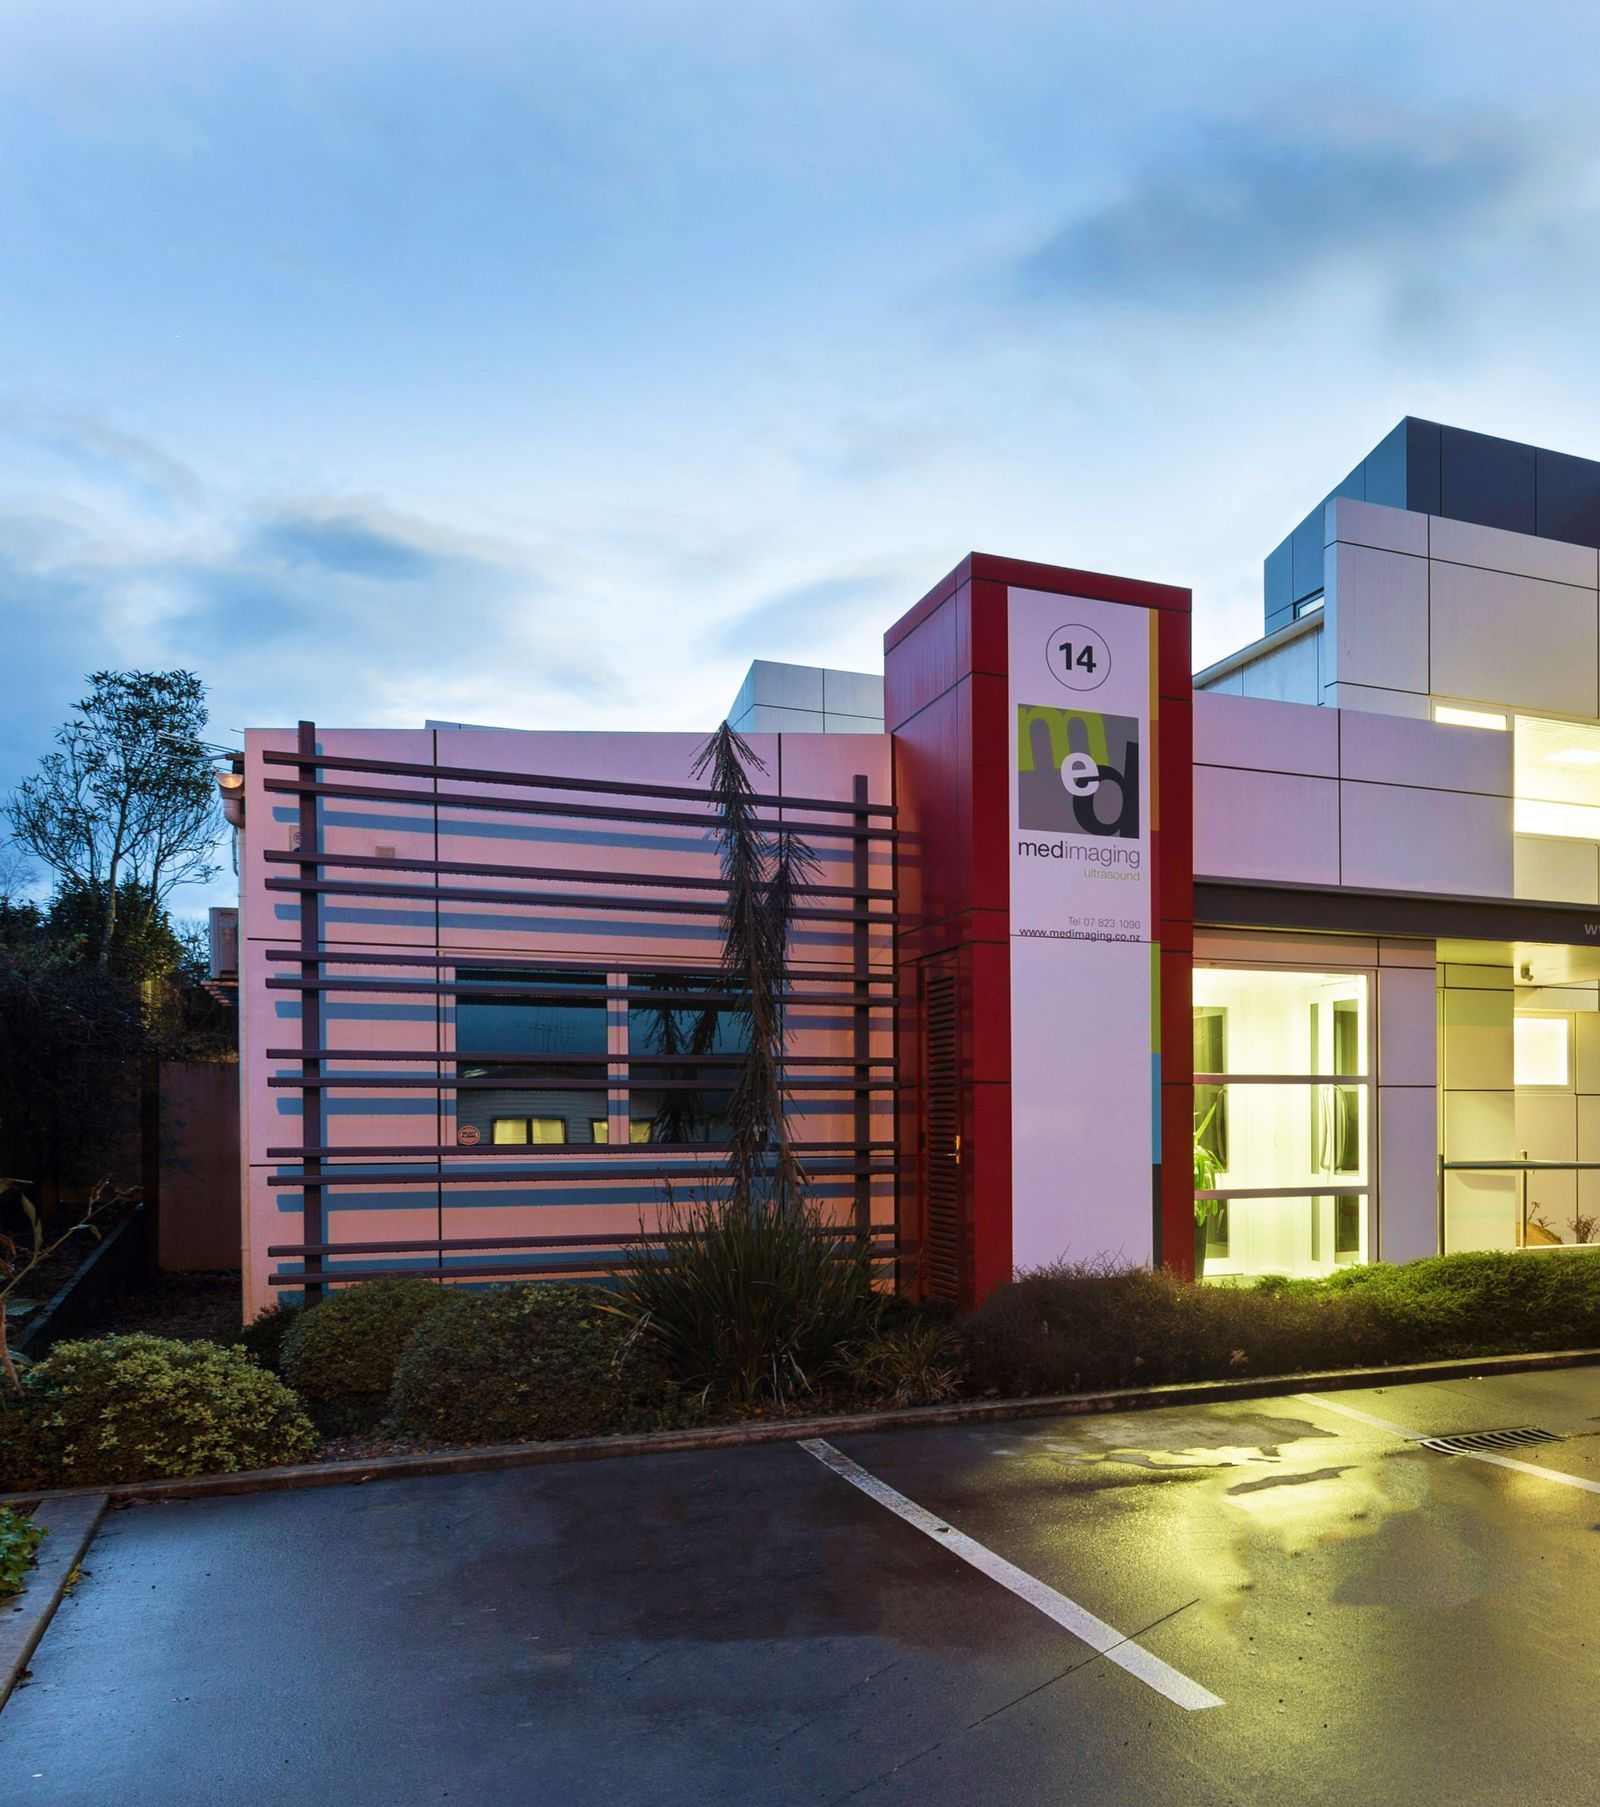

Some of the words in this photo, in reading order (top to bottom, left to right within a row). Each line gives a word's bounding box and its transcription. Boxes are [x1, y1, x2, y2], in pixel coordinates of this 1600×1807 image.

[1059, 642, 1097, 674] 14
[1018, 841, 1141, 869] medimaging
[1084, 867, 1141, 882] ultrasound
[1067, 916, 1081, 926] Tel
[1083, 917, 1096, 927] 07
[1119, 919, 1141, 930] 1090
[1019, 928, 1141, 943] www.medimaging.co.nz
